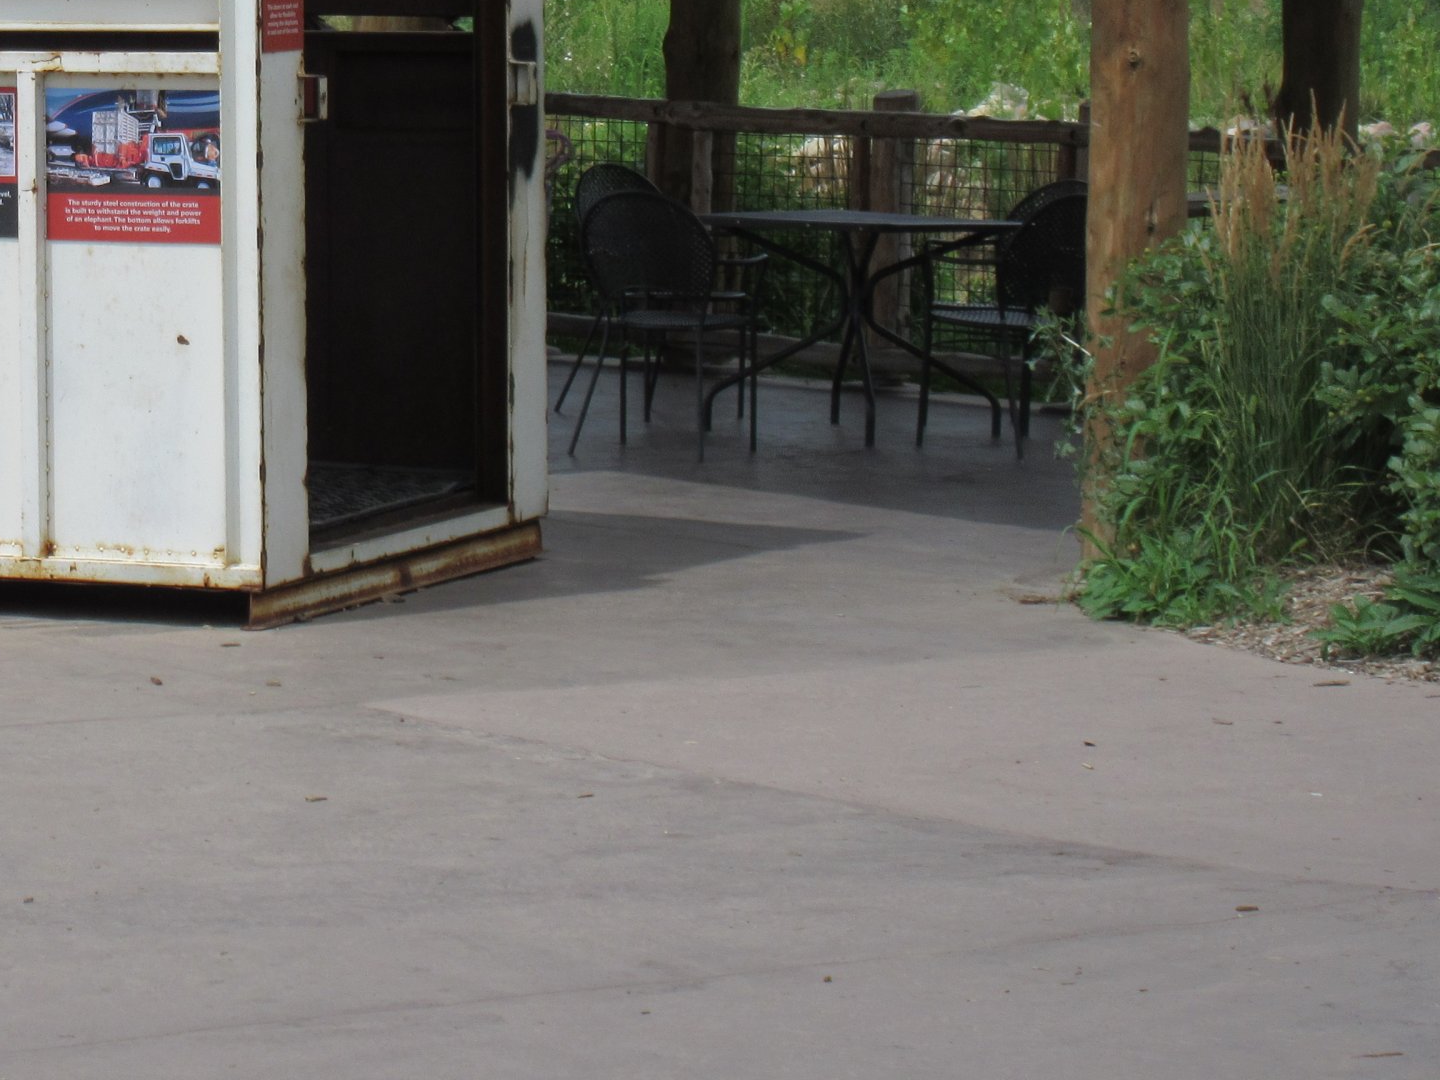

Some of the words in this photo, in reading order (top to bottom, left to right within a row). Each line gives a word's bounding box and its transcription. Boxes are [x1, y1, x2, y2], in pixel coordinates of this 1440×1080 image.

[81, 199, 102, 208] sturdy
[102, 199, 119, 207] steel
[119, 200, 161, 208] construction
[161, 200, 169, 208] of
[170, 200, 181, 208] the
[182, 201, 199, 209] crate
[97, 208, 129, 216] withstand
[129, 208, 142, 216] the
[142, 209, 165, 217] weight
[180, 210, 201, 218] power
[152, 217, 175, 225] allows
[175, 217, 201, 225] forklifts
[121, 224, 133, 232] the
[151, 225, 171, 233] easily.
